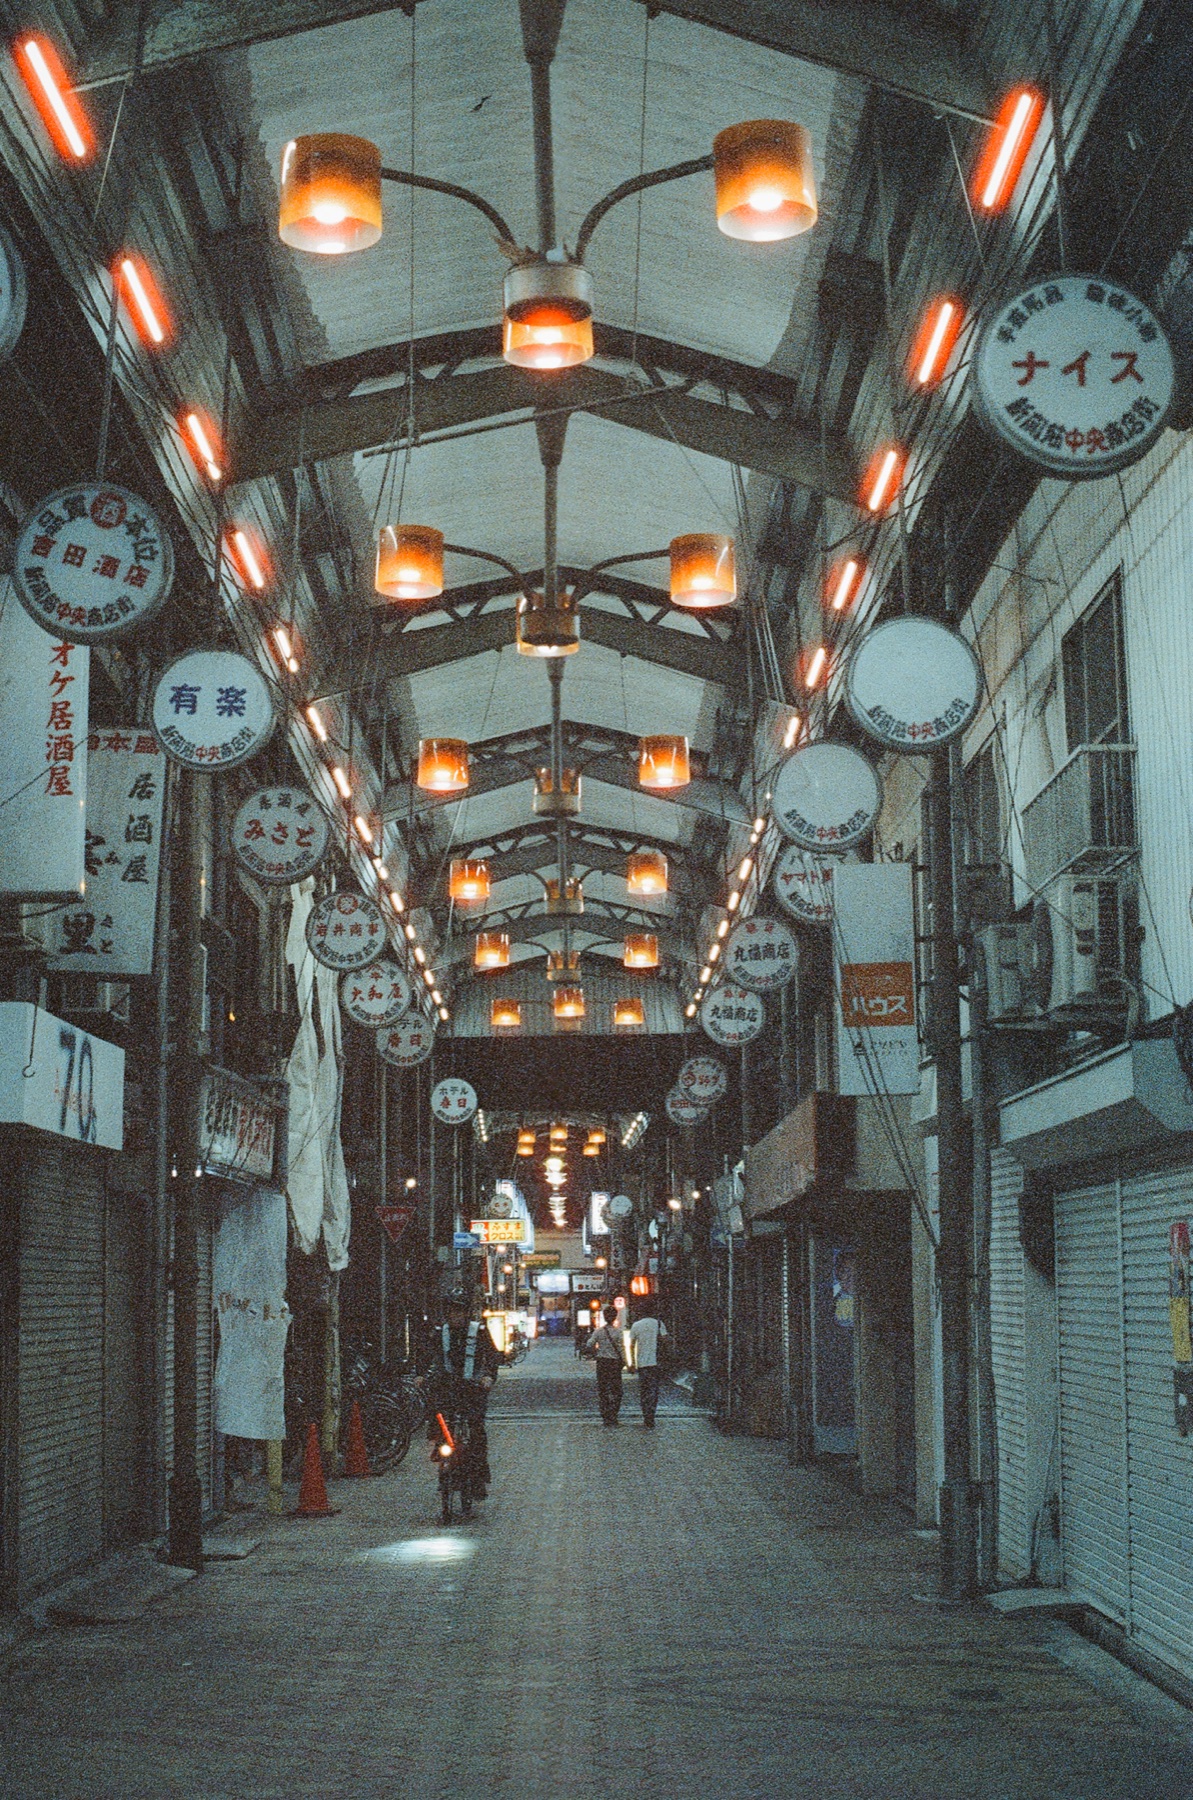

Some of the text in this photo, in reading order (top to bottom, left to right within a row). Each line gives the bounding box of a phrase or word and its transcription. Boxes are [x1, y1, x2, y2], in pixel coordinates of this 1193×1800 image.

[1011, 350, 1144, 387] ナイス
[32, 534, 151, 589] 吉田酒店
[169, 683, 247, 717] 有楽
[121, 773, 157, 885] 居酒屋
[243, 819, 316, 848] みさと
[350, 983, 404, 1003] 大和屋
[851, 995, 908, 1016] ハウス
[438, 1085, 470, 1096] ホテル
[491, 1232, 514, 1241] クロス
